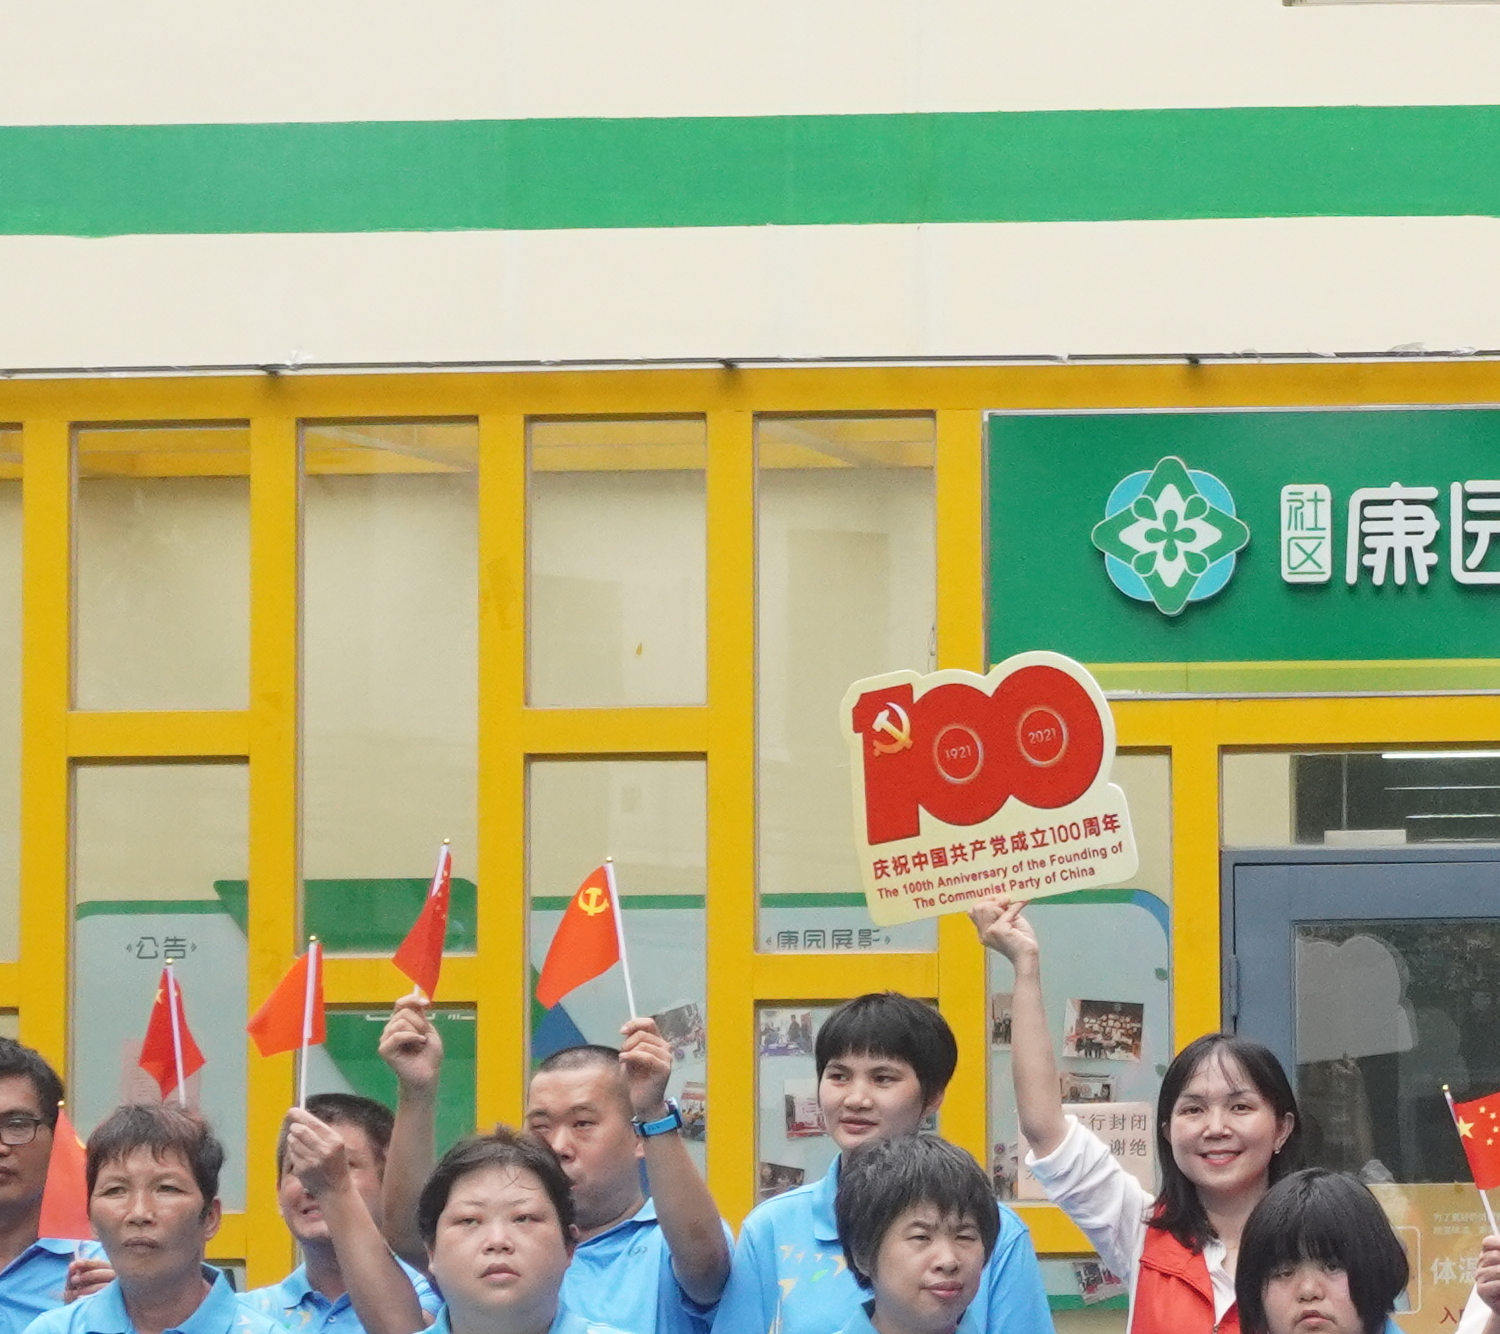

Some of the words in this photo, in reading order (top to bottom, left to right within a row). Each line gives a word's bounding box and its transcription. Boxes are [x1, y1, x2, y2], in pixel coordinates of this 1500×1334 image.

[1285, 490, 1329, 579] 社区
[852, 664, 1105, 846] 100
[945, 745, 972, 759] 1921
[1027, 727, 1057, 745] 2021
[872, 813, 1122, 881] 庆祝中国共产党成立100周年
[876, 886, 900, 901] The
[902, 879, 935, 896] 100th
[936, 866, 1009, 890] Anniversary
[1012, 859, 1025, 874] of
[1026, 855, 1048, 872] the
[1049, 844, 1108, 867] Founding
[1110, 841, 1124, 855] of
[912, 895, 936, 911] The
[938, 883, 1008, 905] Communist
[1009, 875, 1041, 896] Party
[1044, 871, 1057, 886] of
[1059, 864, 1096, 882] China
[135, 935, 188, 960] 公告
[776, 928, 881, 950] 康园展影
